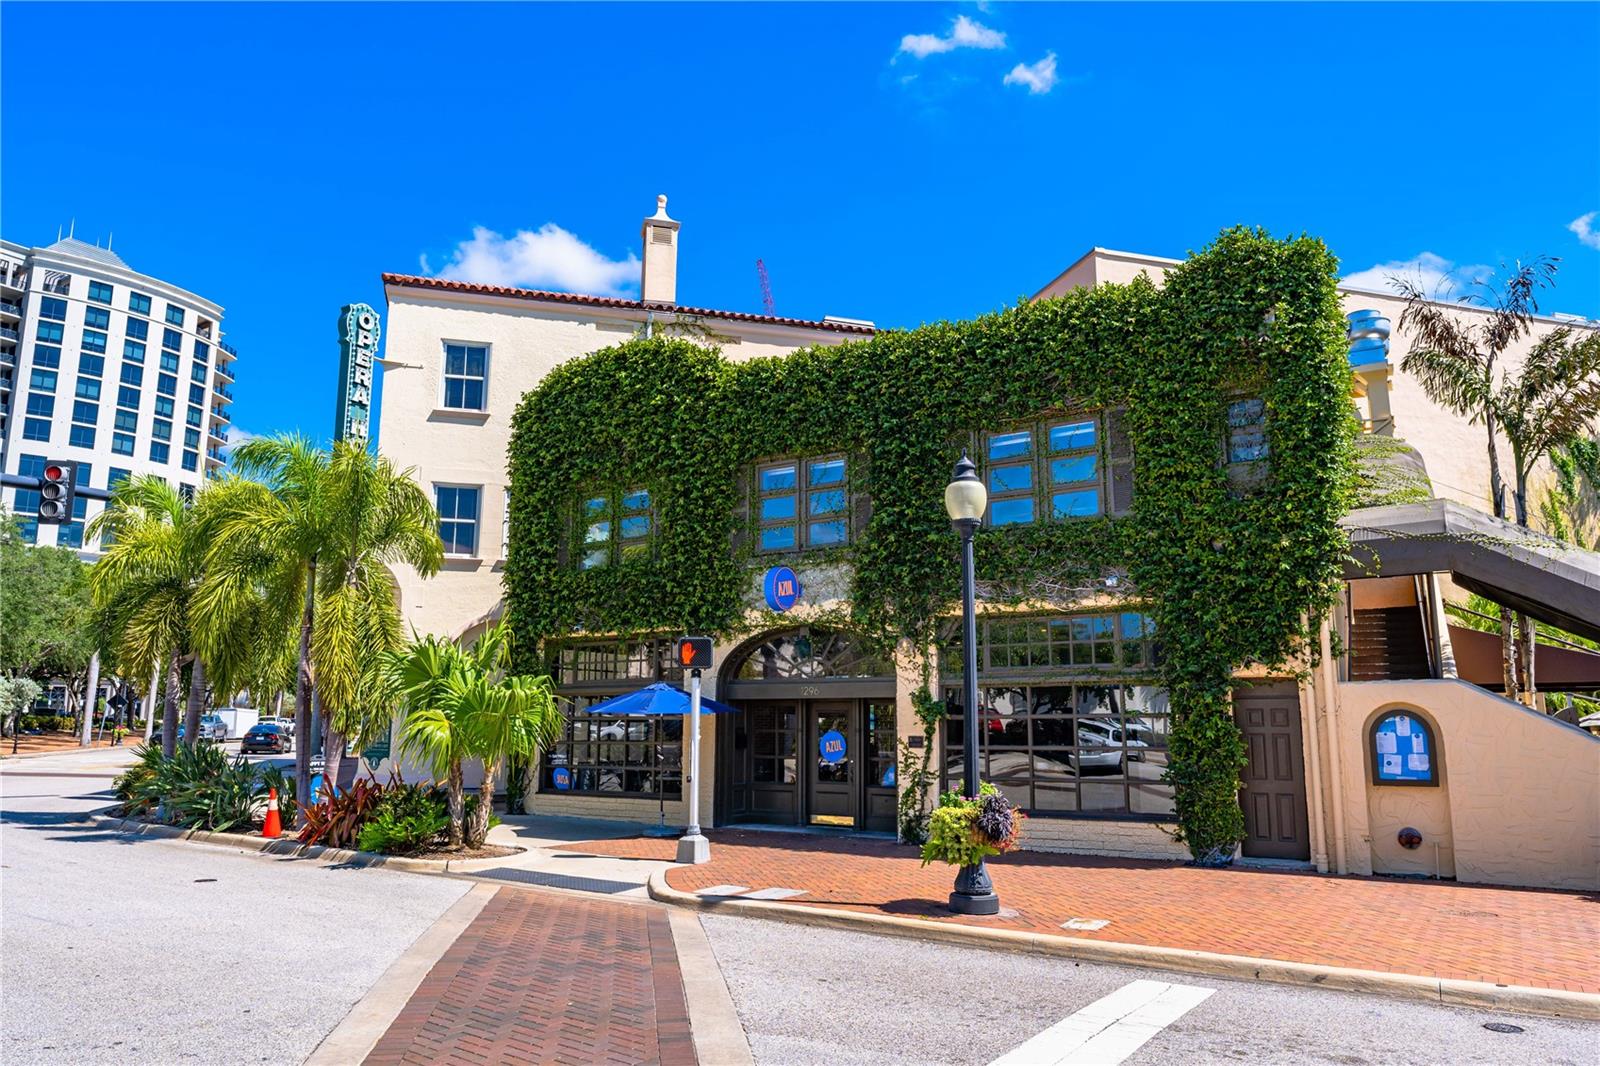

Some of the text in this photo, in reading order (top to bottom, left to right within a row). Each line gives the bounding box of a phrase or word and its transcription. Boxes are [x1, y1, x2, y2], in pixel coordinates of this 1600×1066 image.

[352, 312, 376, 405] OPERA
[778, 580, 795, 597] AZUL
[800, 686, 821, 697] 1296
[825, 739, 843, 753] AZUL
